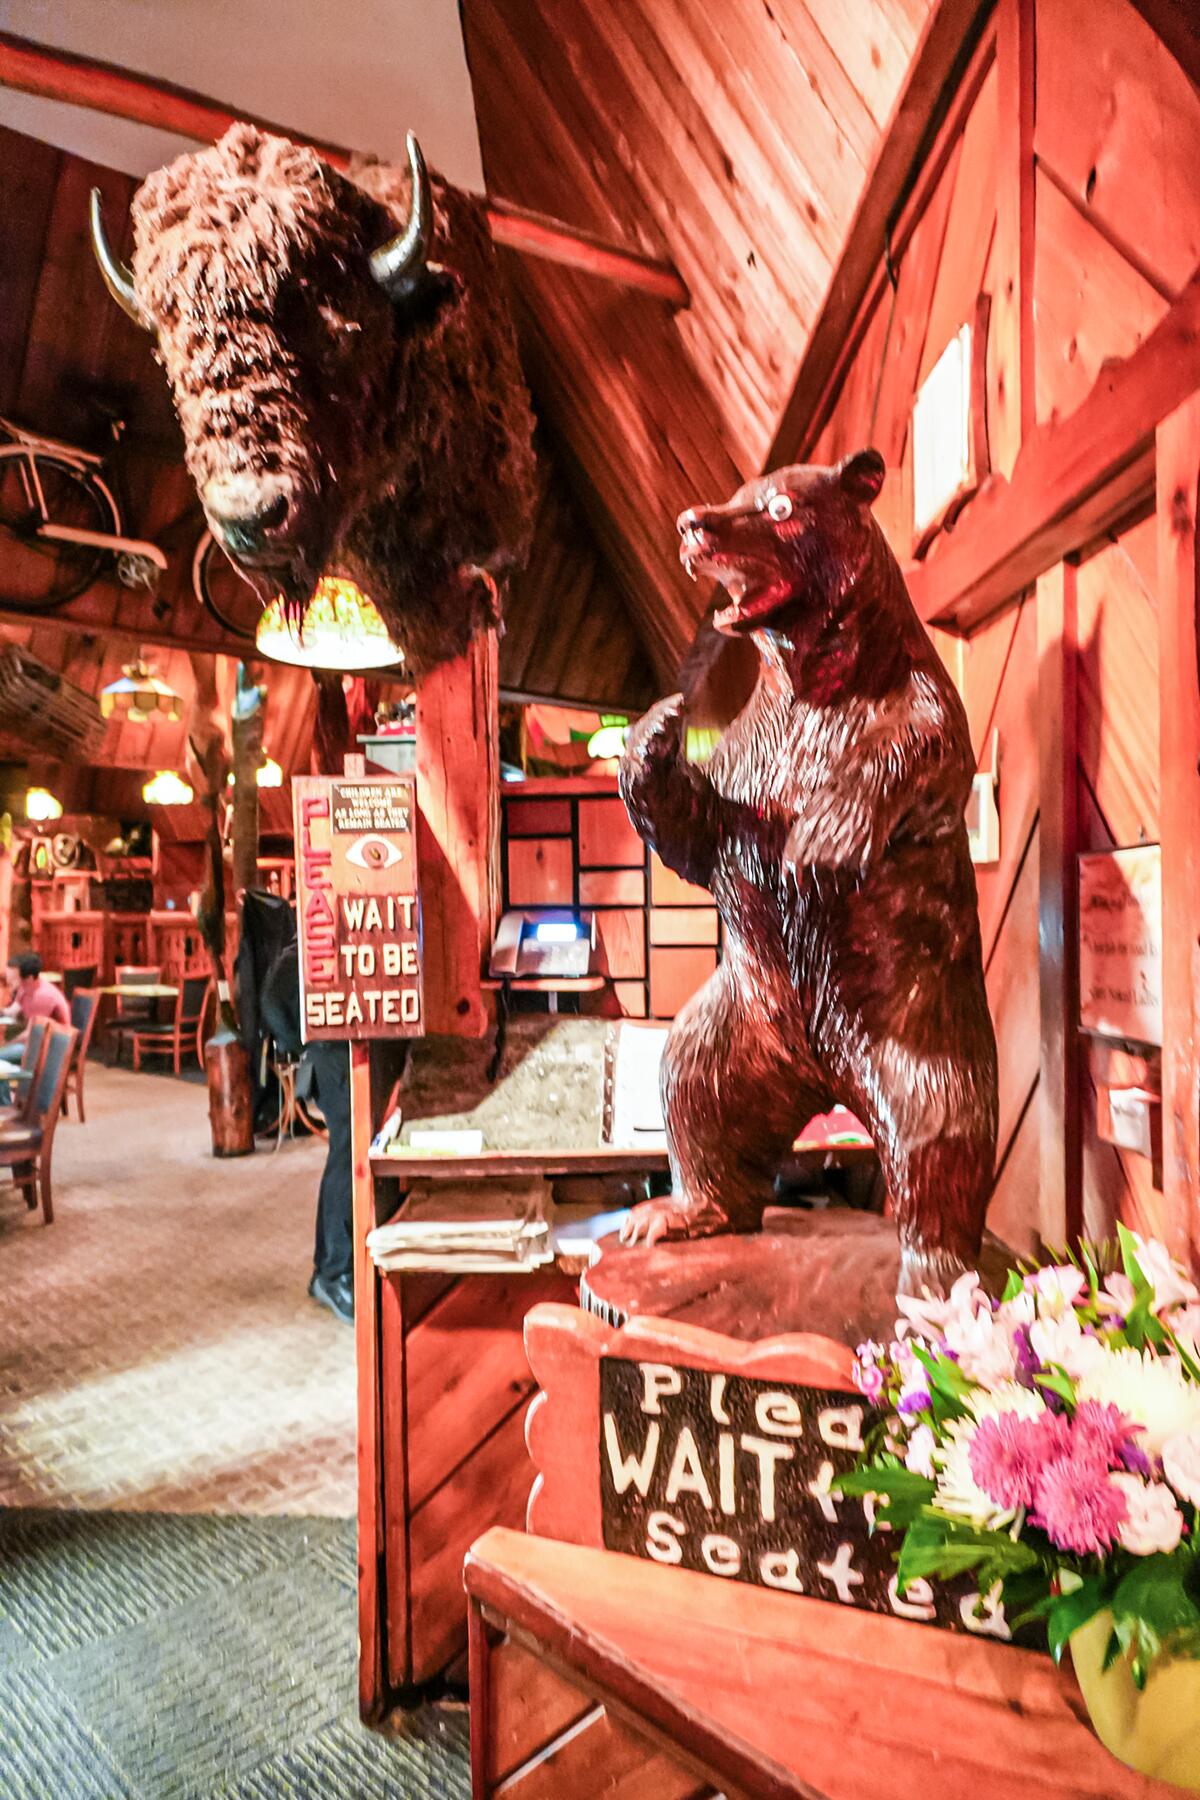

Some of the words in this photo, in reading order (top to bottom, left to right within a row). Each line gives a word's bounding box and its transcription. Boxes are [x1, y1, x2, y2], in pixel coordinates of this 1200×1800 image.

[339, 786, 382, 799] CHILDREN
[351, 797, 392, 808] WELCOME
[338, 818, 373, 829] REMAIN
[374, 817, 407, 829] SEATED
[348, 807, 371, 819] LONG
[373, 807, 386, 819] AS
[386, 807, 409, 818] THEY
[302, 798, 336, 986] PLEASE
[343, 895, 416, 932] WAIT
[340, 944, 376, 978] TO
[383, 941, 419, 977] BE
[306, 988, 420, 1026] SEATED
[603, 1412, 796, 1523] WAIT
